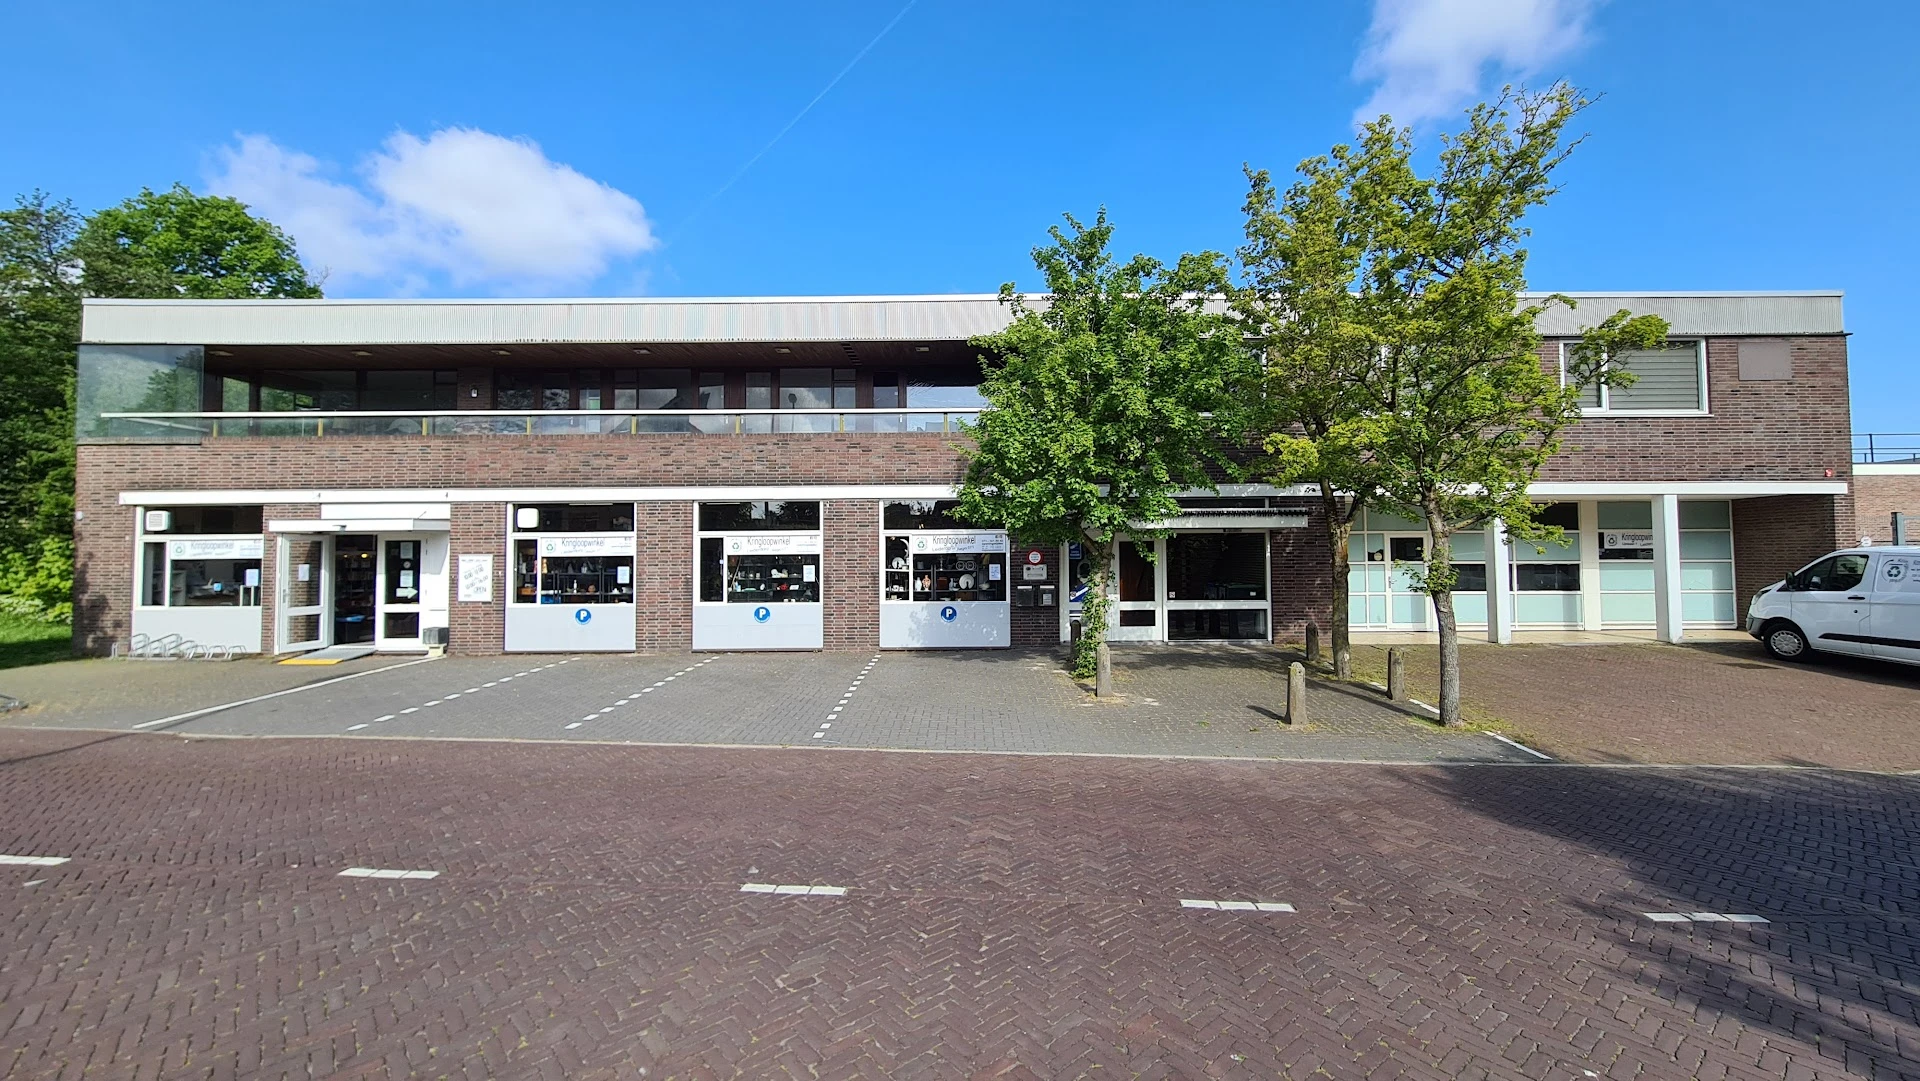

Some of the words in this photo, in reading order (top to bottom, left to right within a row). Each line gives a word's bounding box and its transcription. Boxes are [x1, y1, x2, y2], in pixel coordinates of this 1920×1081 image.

[561, 537, 605, 549] Kringloopwinkel
[747, 535, 791, 548] Kringloopwinkel
[932, 535, 976, 547] Kringloopwinkel
[580, 610, 588, 621] P
[759, 608, 767, 619] P
[946, 608, 953, 618] P
